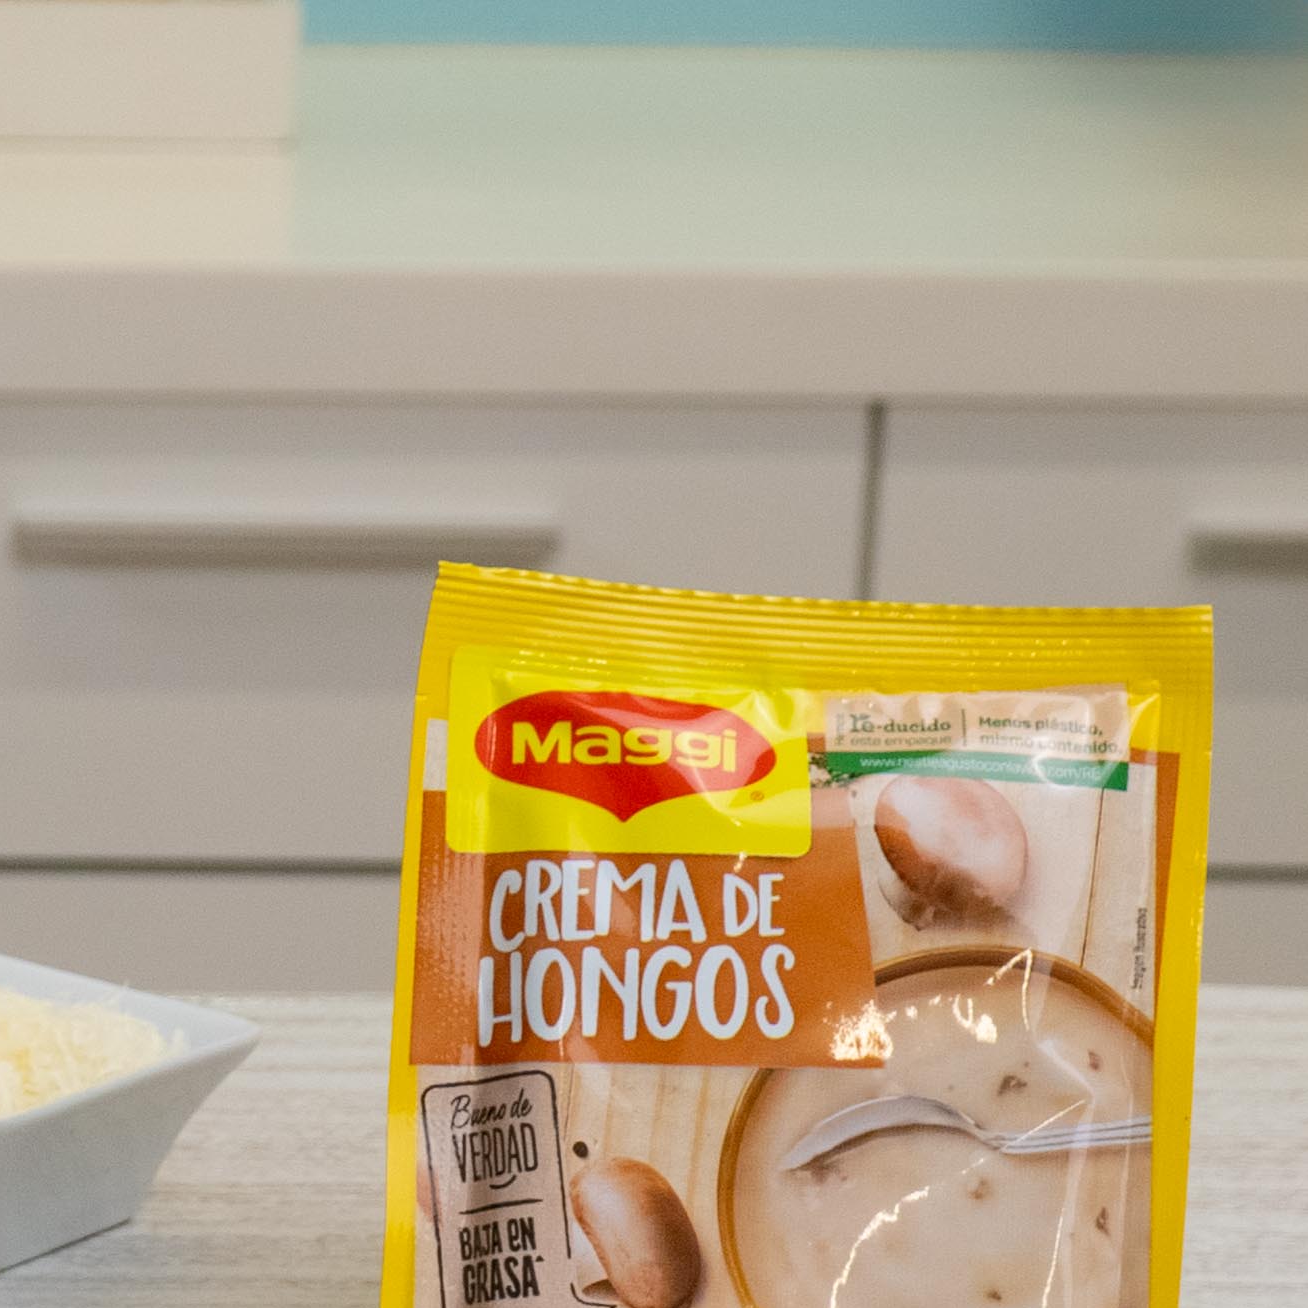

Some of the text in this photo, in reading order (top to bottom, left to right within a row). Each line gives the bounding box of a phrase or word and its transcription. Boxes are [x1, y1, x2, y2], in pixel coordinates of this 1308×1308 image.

[512, 721, 737, 773] Maggi
[979, 716, 1031, 729] Menos
[489, 859, 785, 953] CREMA DE
[478, 944, 796, 1048] HONGOS
[451, 1087, 532, 1130] Bueno de
[452, 1122, 539, 1183] VERDAD
[459, 1221, 503, 1261] BAJA
